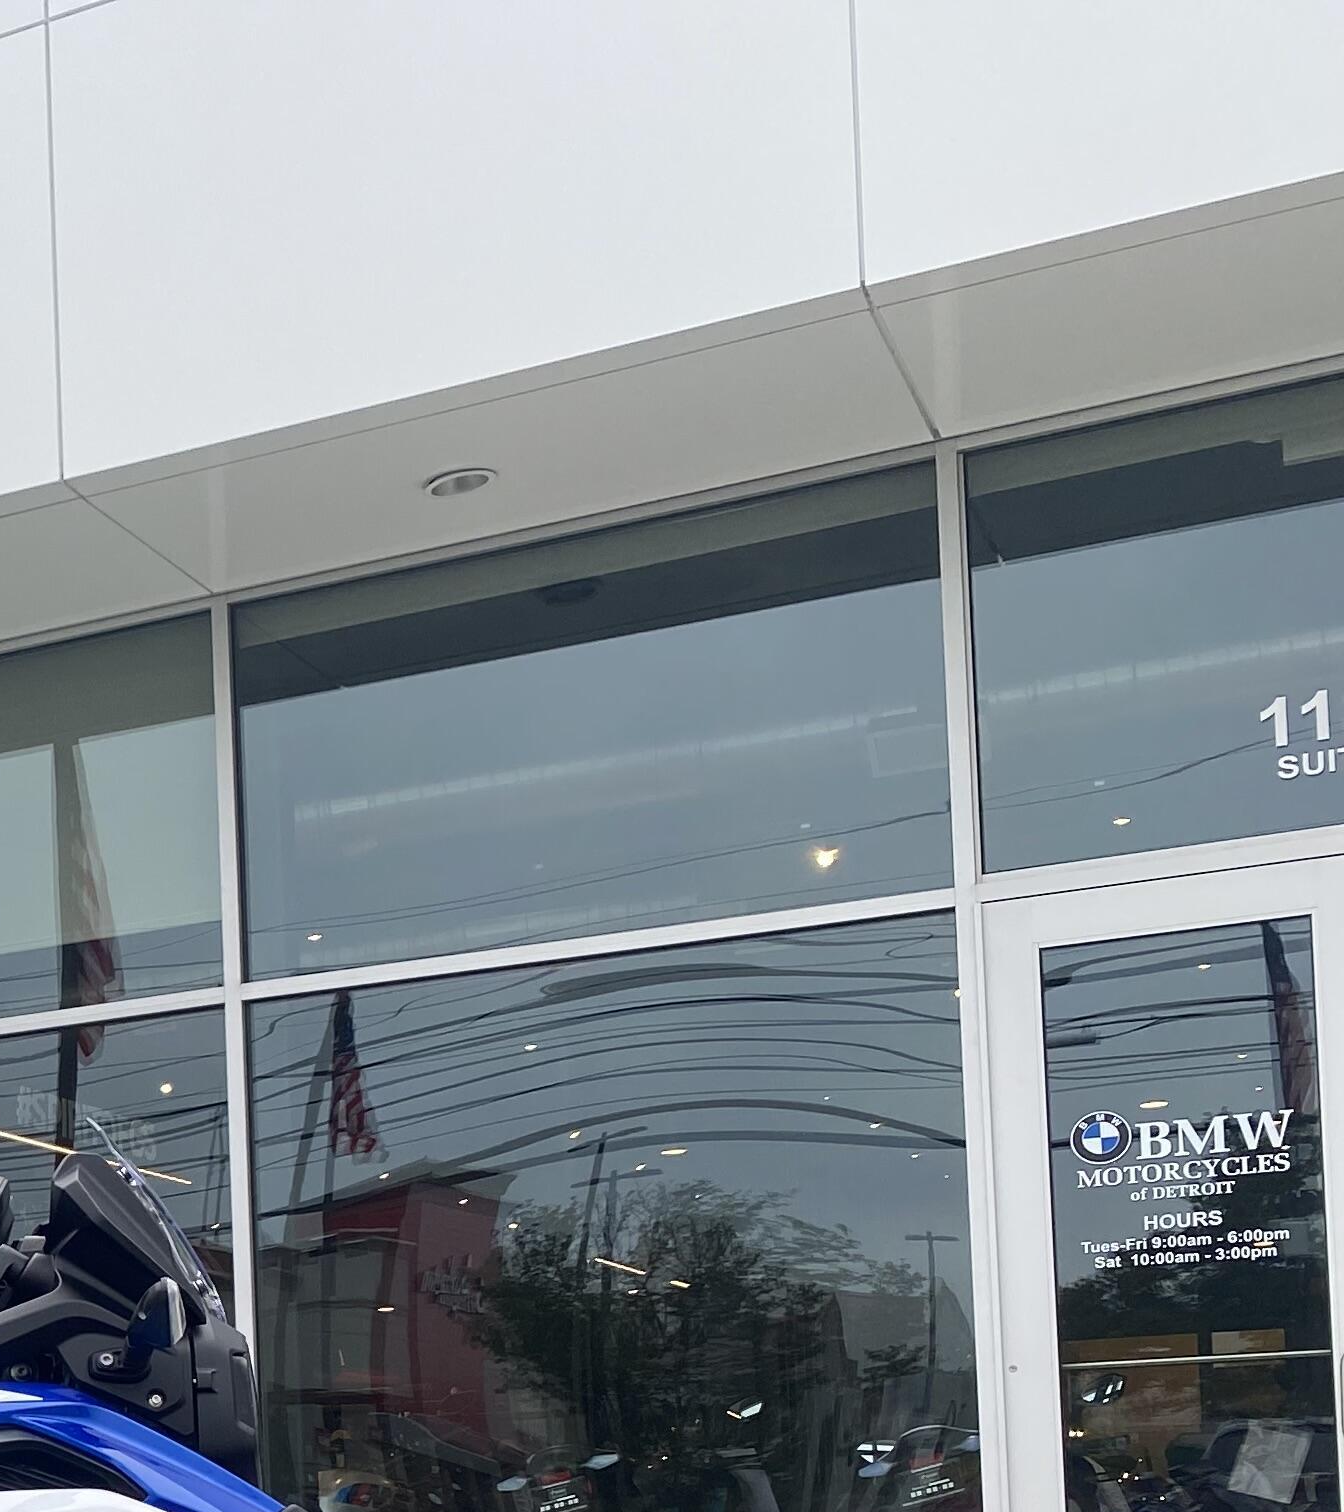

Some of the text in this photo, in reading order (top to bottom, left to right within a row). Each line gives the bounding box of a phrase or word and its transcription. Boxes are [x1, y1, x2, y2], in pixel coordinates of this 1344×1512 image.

[1134, 1109, 1294, 1161] BMW
[1077, 1151, 1292, 1189] MOTORCYCLES
[1130, 1180, 1236, 1202] of DETROIT
[1143, 1210, 1223, 1231] HOURS
[1081, 1238, 1148, 1255] Tues-Fri
[1151, 1233, 1213, 1250] 9:00am
[1227, 1228, 1291, 1247] 6:00pm
[1094, 1256, 1122, 1270] Sat
[1130, 1251, 1200, 1268] 10:00am
[1215, 1245, 1279, 1263] 3:00pm
